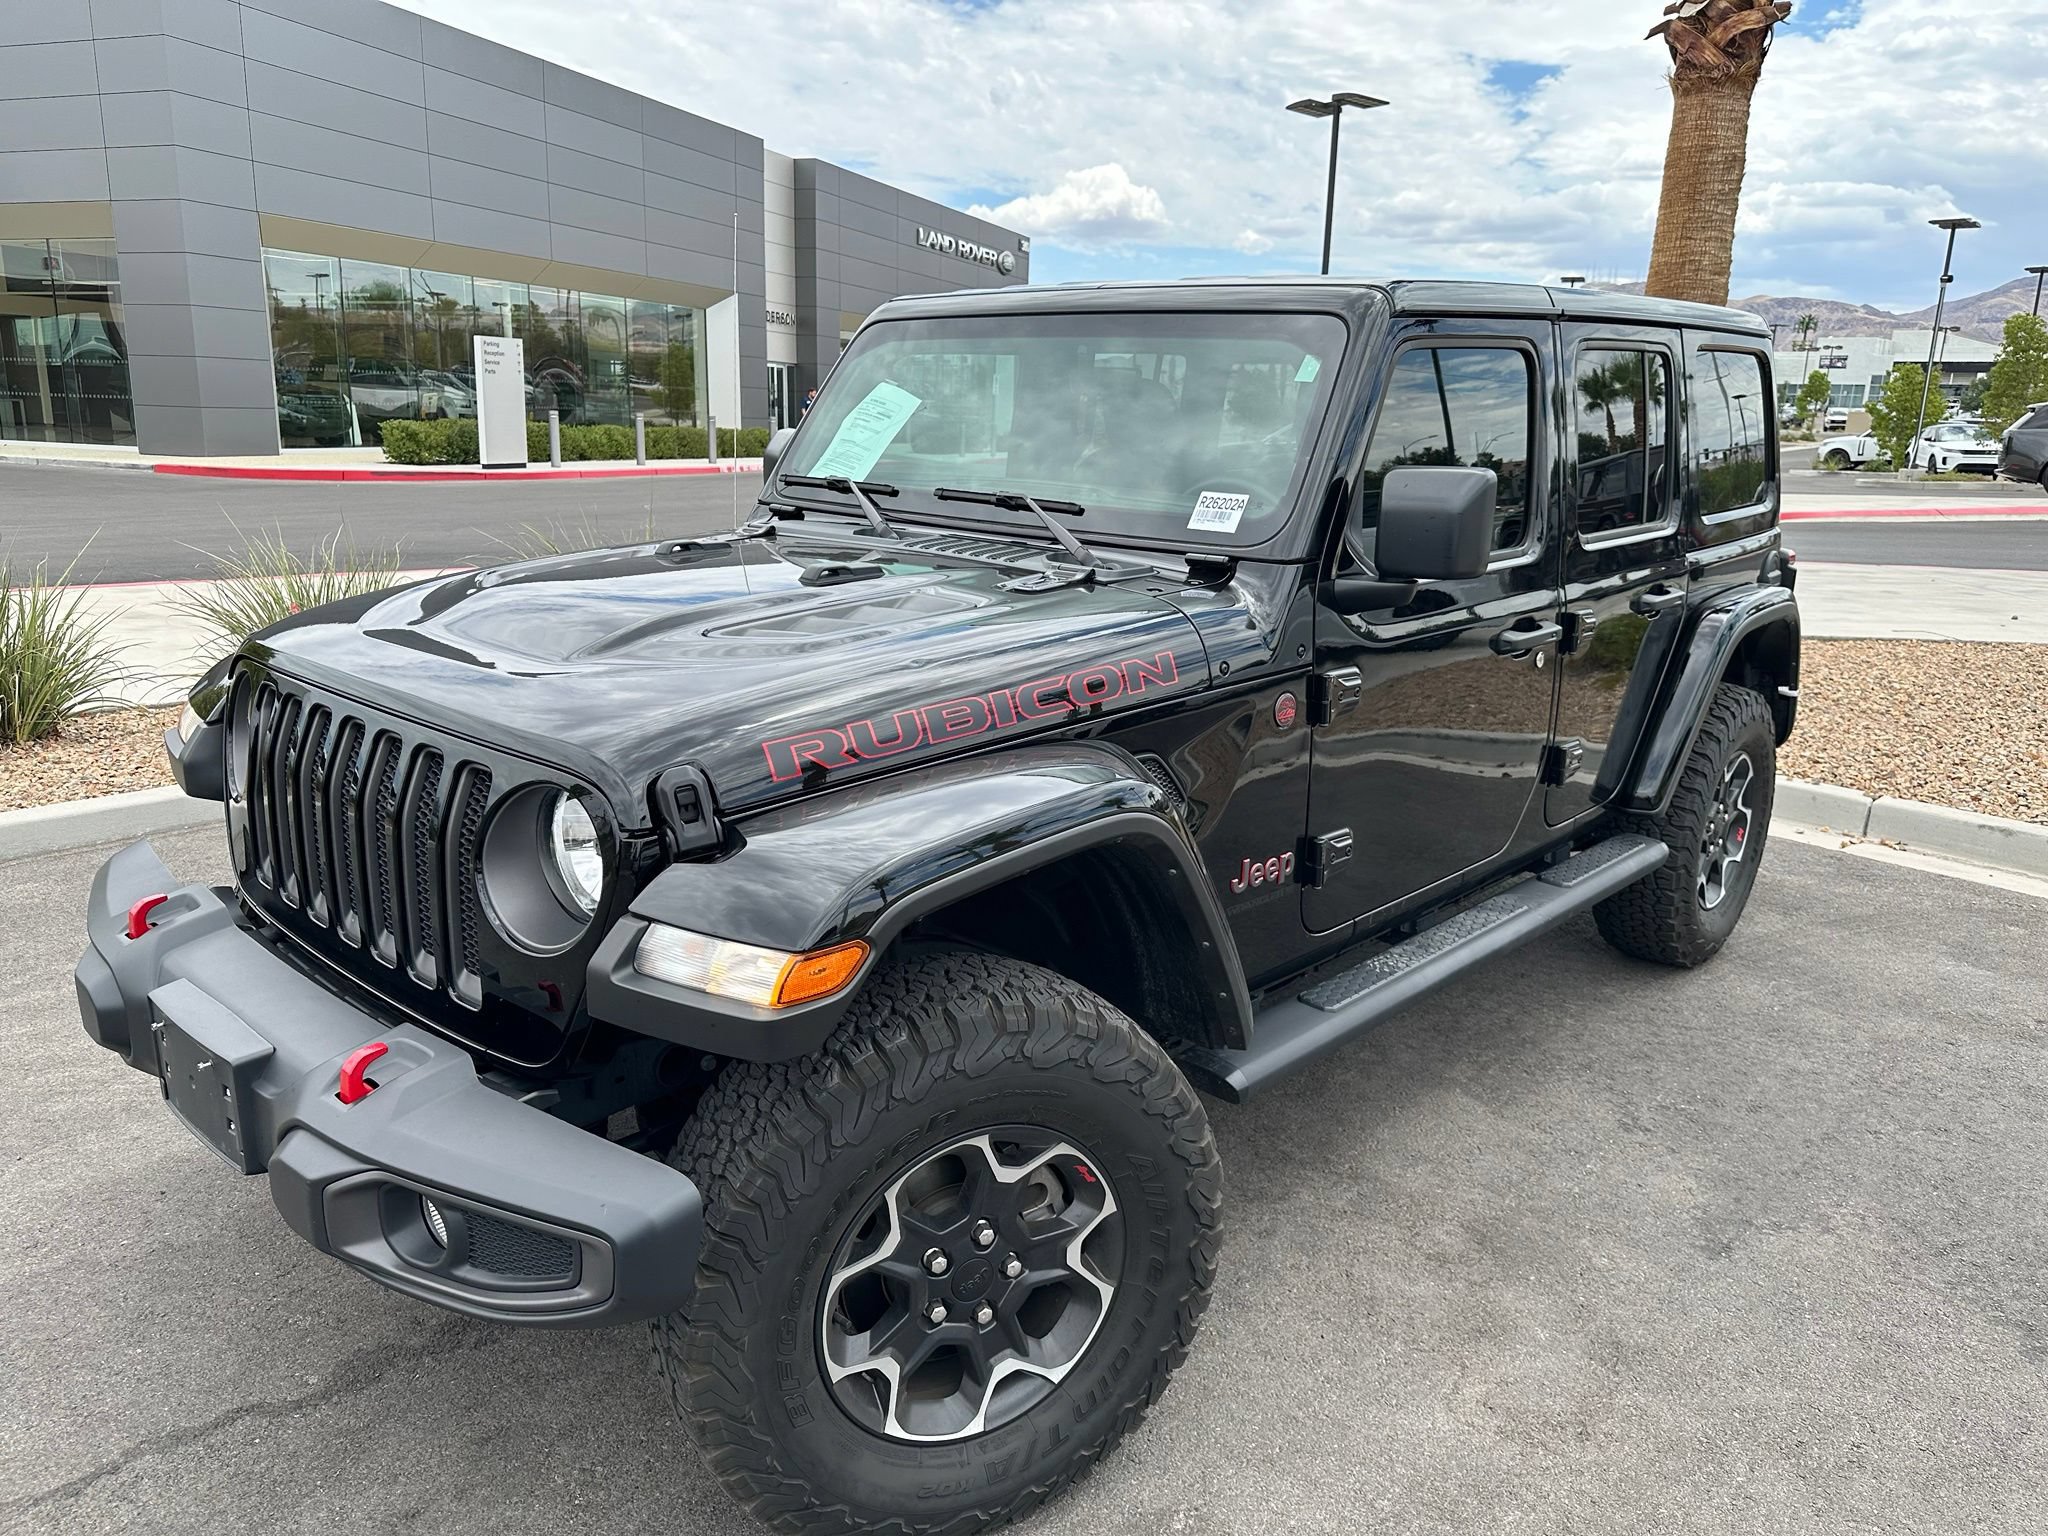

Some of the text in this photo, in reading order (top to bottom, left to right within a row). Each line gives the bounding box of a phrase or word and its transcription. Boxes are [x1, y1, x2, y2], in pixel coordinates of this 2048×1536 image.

[917, 227, 955, 253] LAND
[956, 239, 998, 267] ROVER
[483, 340, 500, 349] Parking
[1199, 495, 1245, 512] R26202A
[761, 651, 1180, 782] RUBICON
[1230, 851, 1296, 895] Jeep
